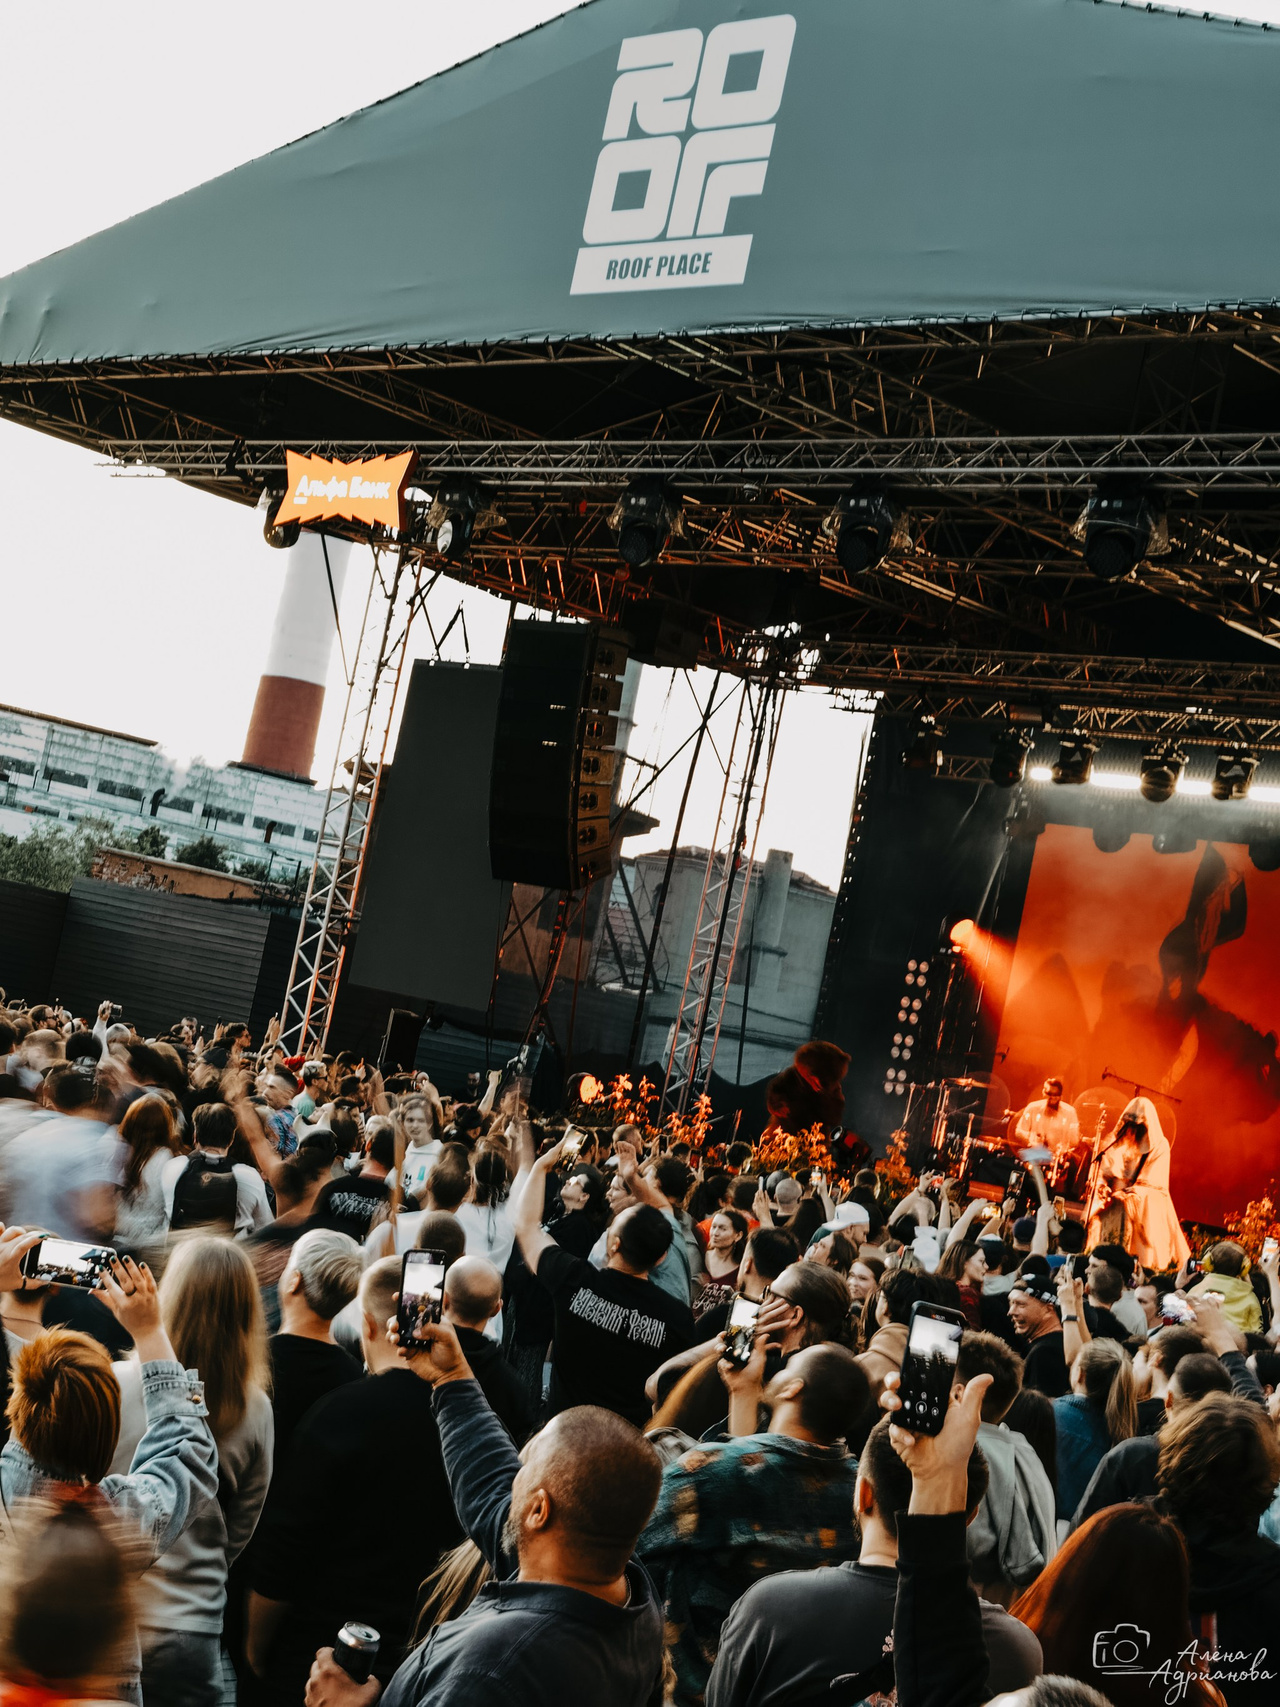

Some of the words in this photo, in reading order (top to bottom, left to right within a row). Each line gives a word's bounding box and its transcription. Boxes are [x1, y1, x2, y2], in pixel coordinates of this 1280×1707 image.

[605, 256, 654, 281] ROOF
[655, 251, 713, 278] PLACE
[294, 474, 348, 503] Альфа
[349, 475, 392, 500] Банк
